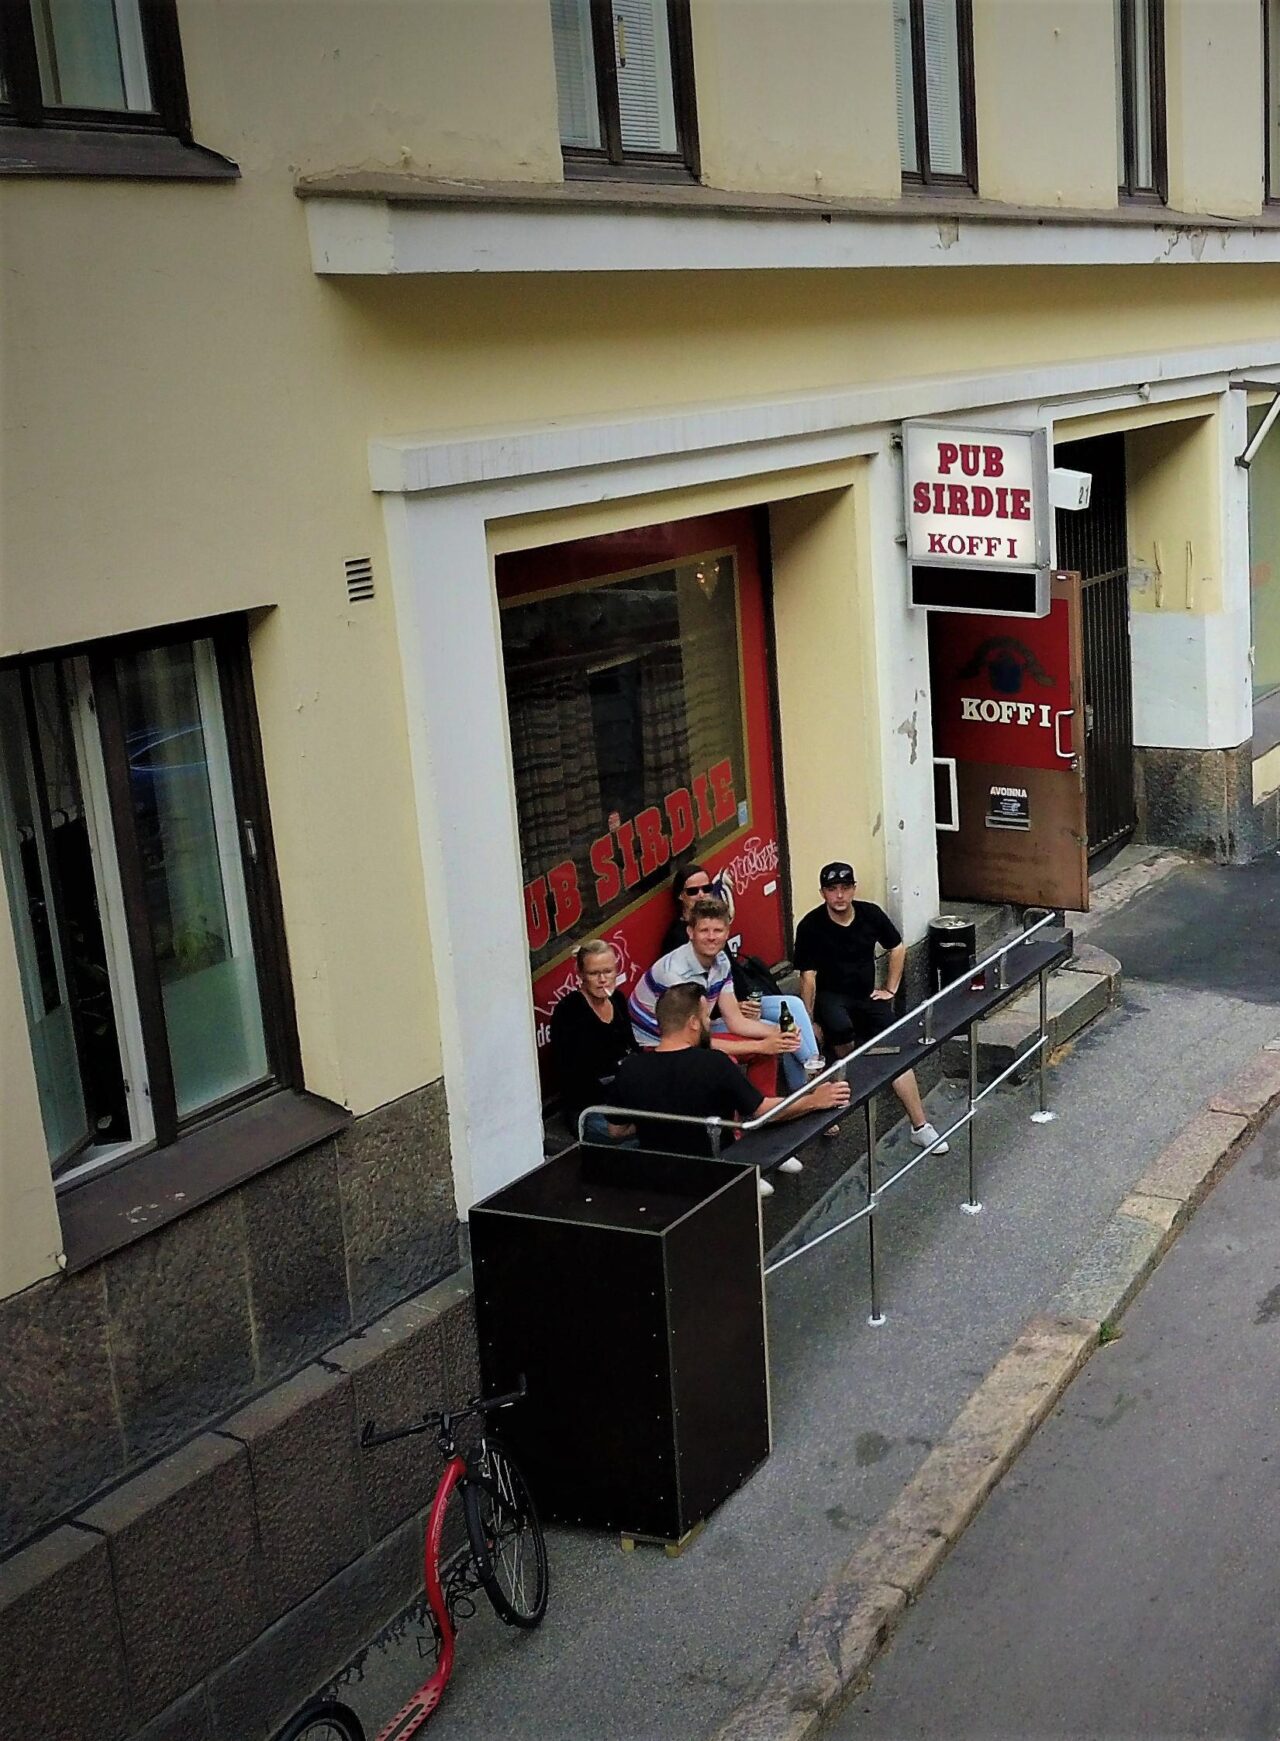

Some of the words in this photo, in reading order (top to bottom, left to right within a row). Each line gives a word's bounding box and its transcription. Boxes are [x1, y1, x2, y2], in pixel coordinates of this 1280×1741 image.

[938, 443, 1004, 477] PUB
[913, 482, 1031, 521] SIRDIE
[1078, 486, 1090, 505] 21
[990, 786, 1028, 798] AVOINNA
[523, 860, 582, 952] UB
[590, 757, 737, 907] SIRDIE
